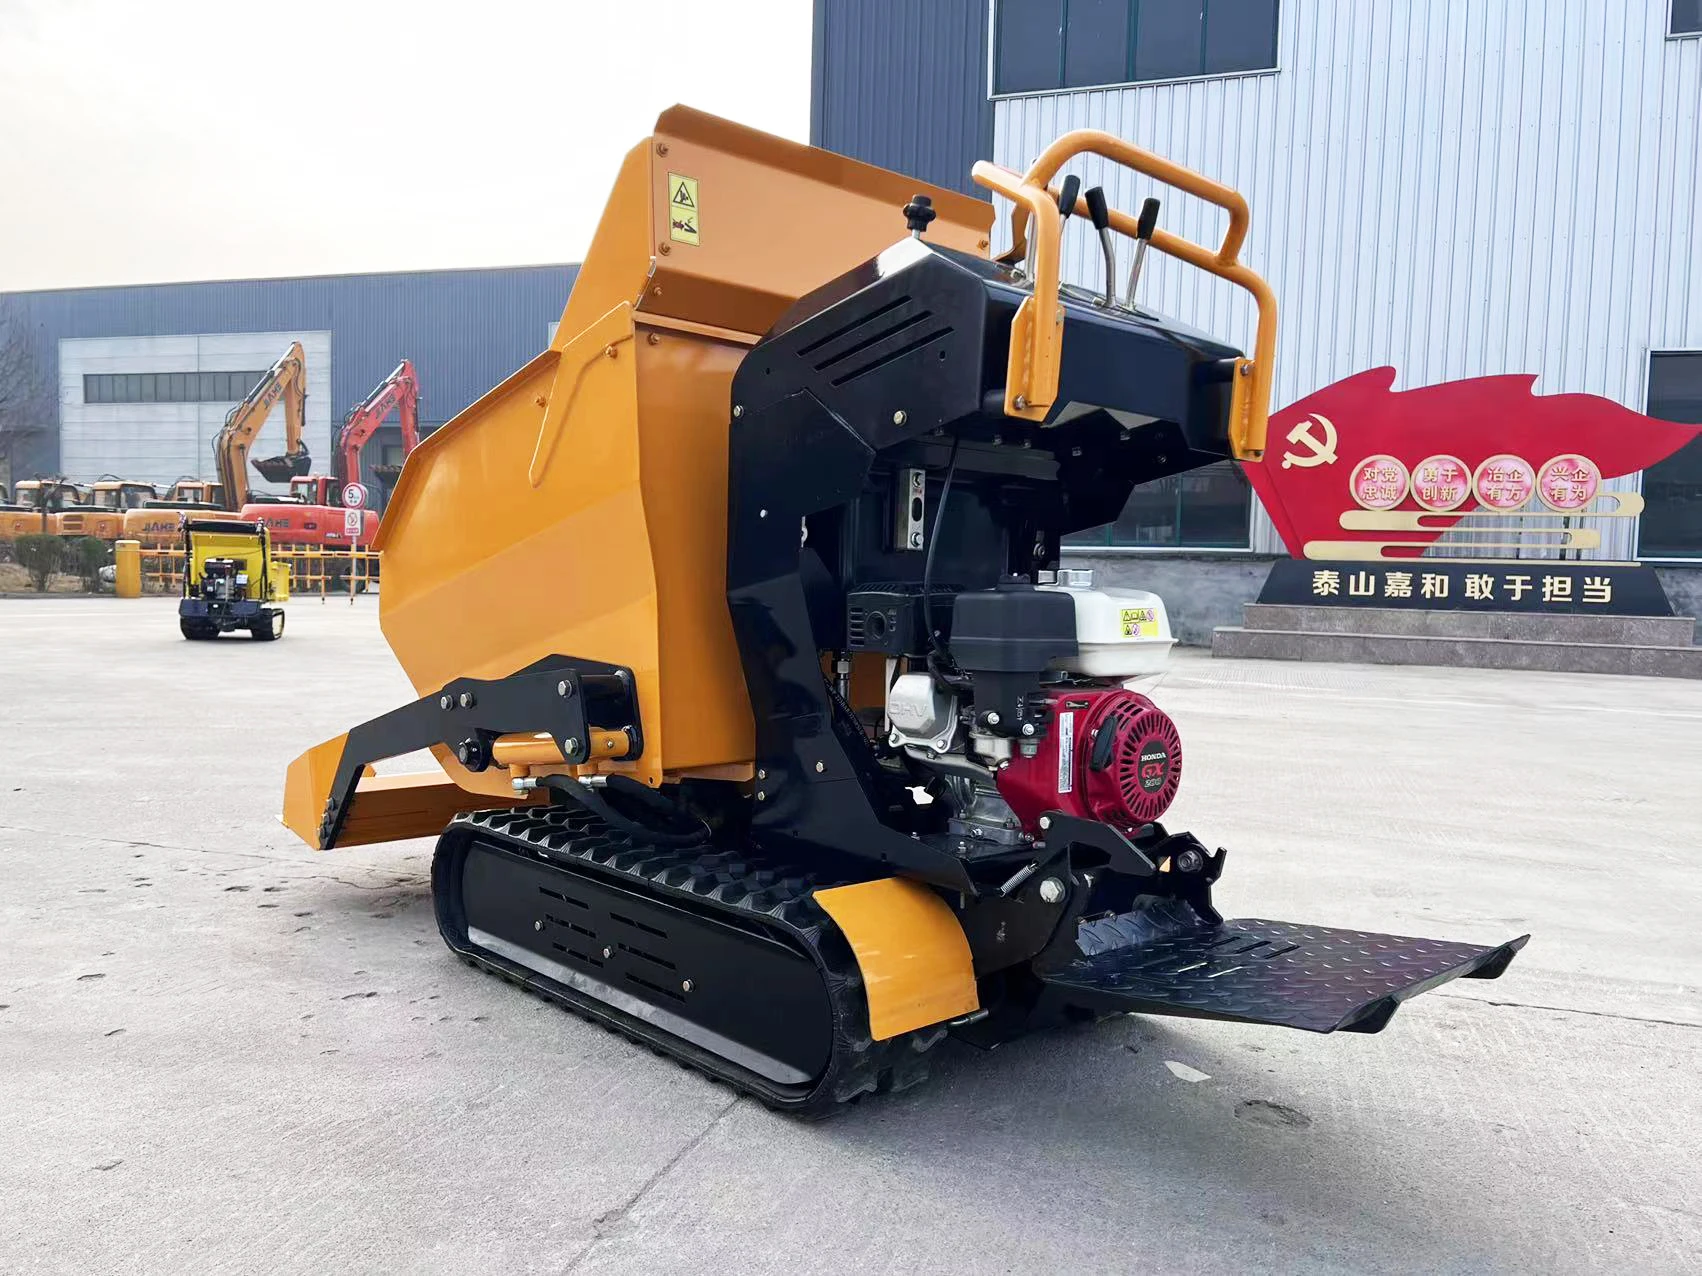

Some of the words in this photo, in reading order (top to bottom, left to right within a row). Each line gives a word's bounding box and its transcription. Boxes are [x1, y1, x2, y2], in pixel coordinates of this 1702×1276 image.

[1364, 467, 1398, 482] 对党
[1423, 467, 1459, 482] 勇于
[1487, 466, 1524, 482] 治企
[1551, 466, 1589, 482] 兴企
[1362, 485, 1398, 501] 忠诚
[1422, 486, 1459, 501] 创新
[1487, 485, 1523, 502] 有方
[1550, 485, 1587, 501] 有为
[1312, 569, 1449, 599] 泰山嘉和
[1464, 573, 1612, 603] 敢于担当
[1141, 752, 1167, 762] HONDA
[1141, 762, 1165, 779] GX
